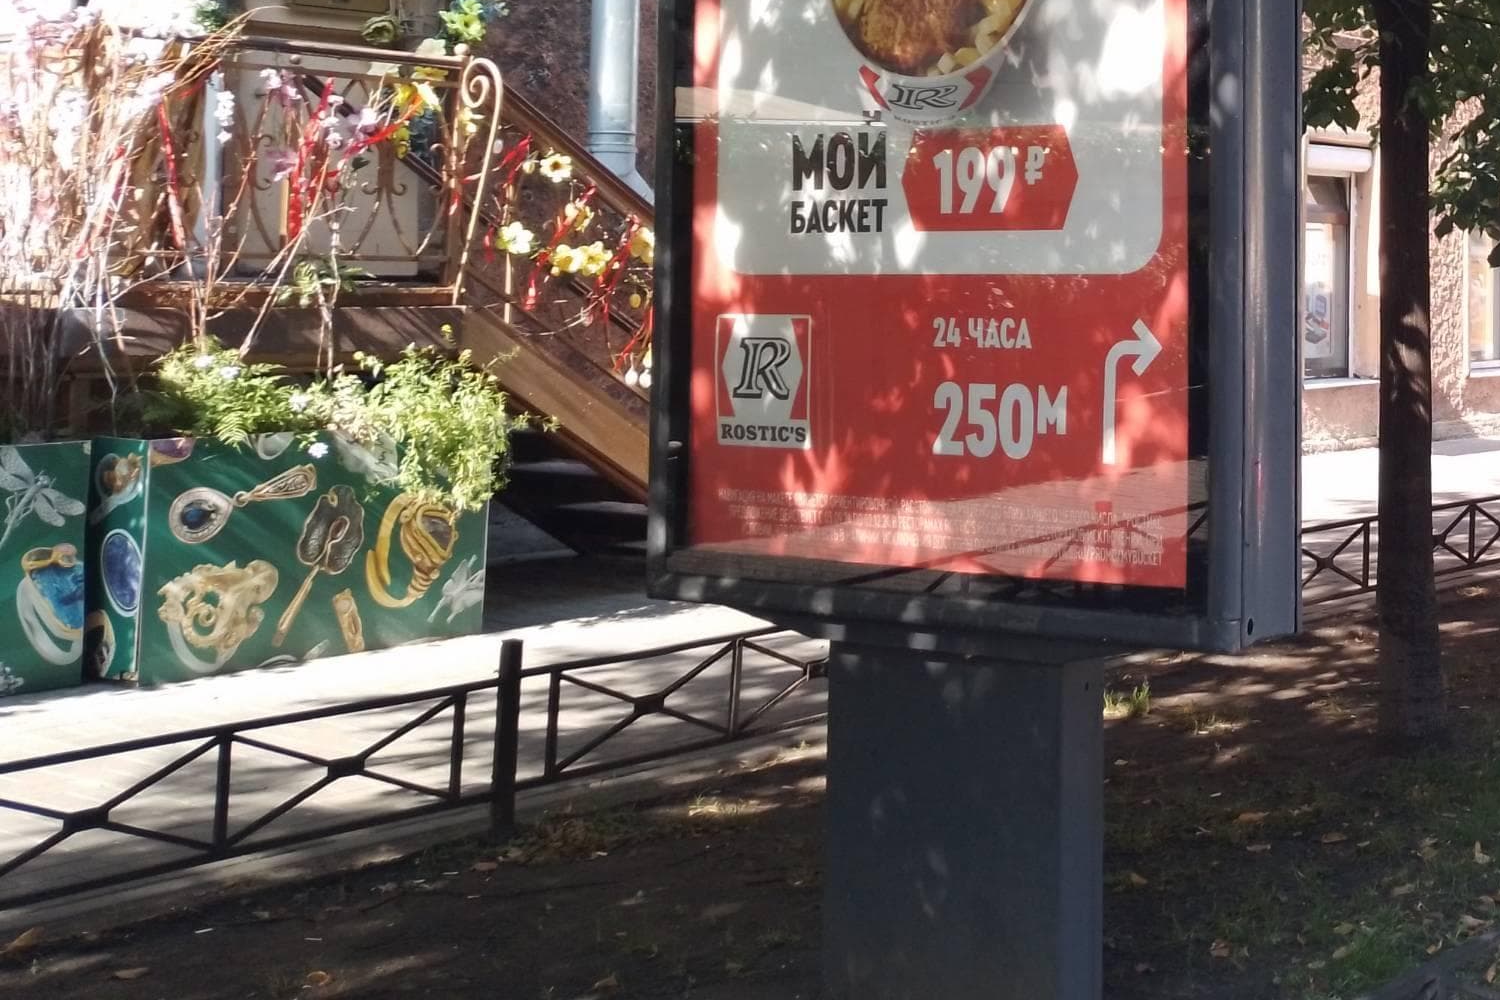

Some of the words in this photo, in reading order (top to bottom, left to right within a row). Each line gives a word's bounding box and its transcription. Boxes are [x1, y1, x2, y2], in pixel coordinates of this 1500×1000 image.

[791, 111, 887, 192] МОЙ
[790, 199, 888, 234] БАСКЕТ
[932, 317, 961, 348] 24
[968, 317, 1033, 349] ЧАСА
[720, 423, 807, 443] ROSTIC'S
